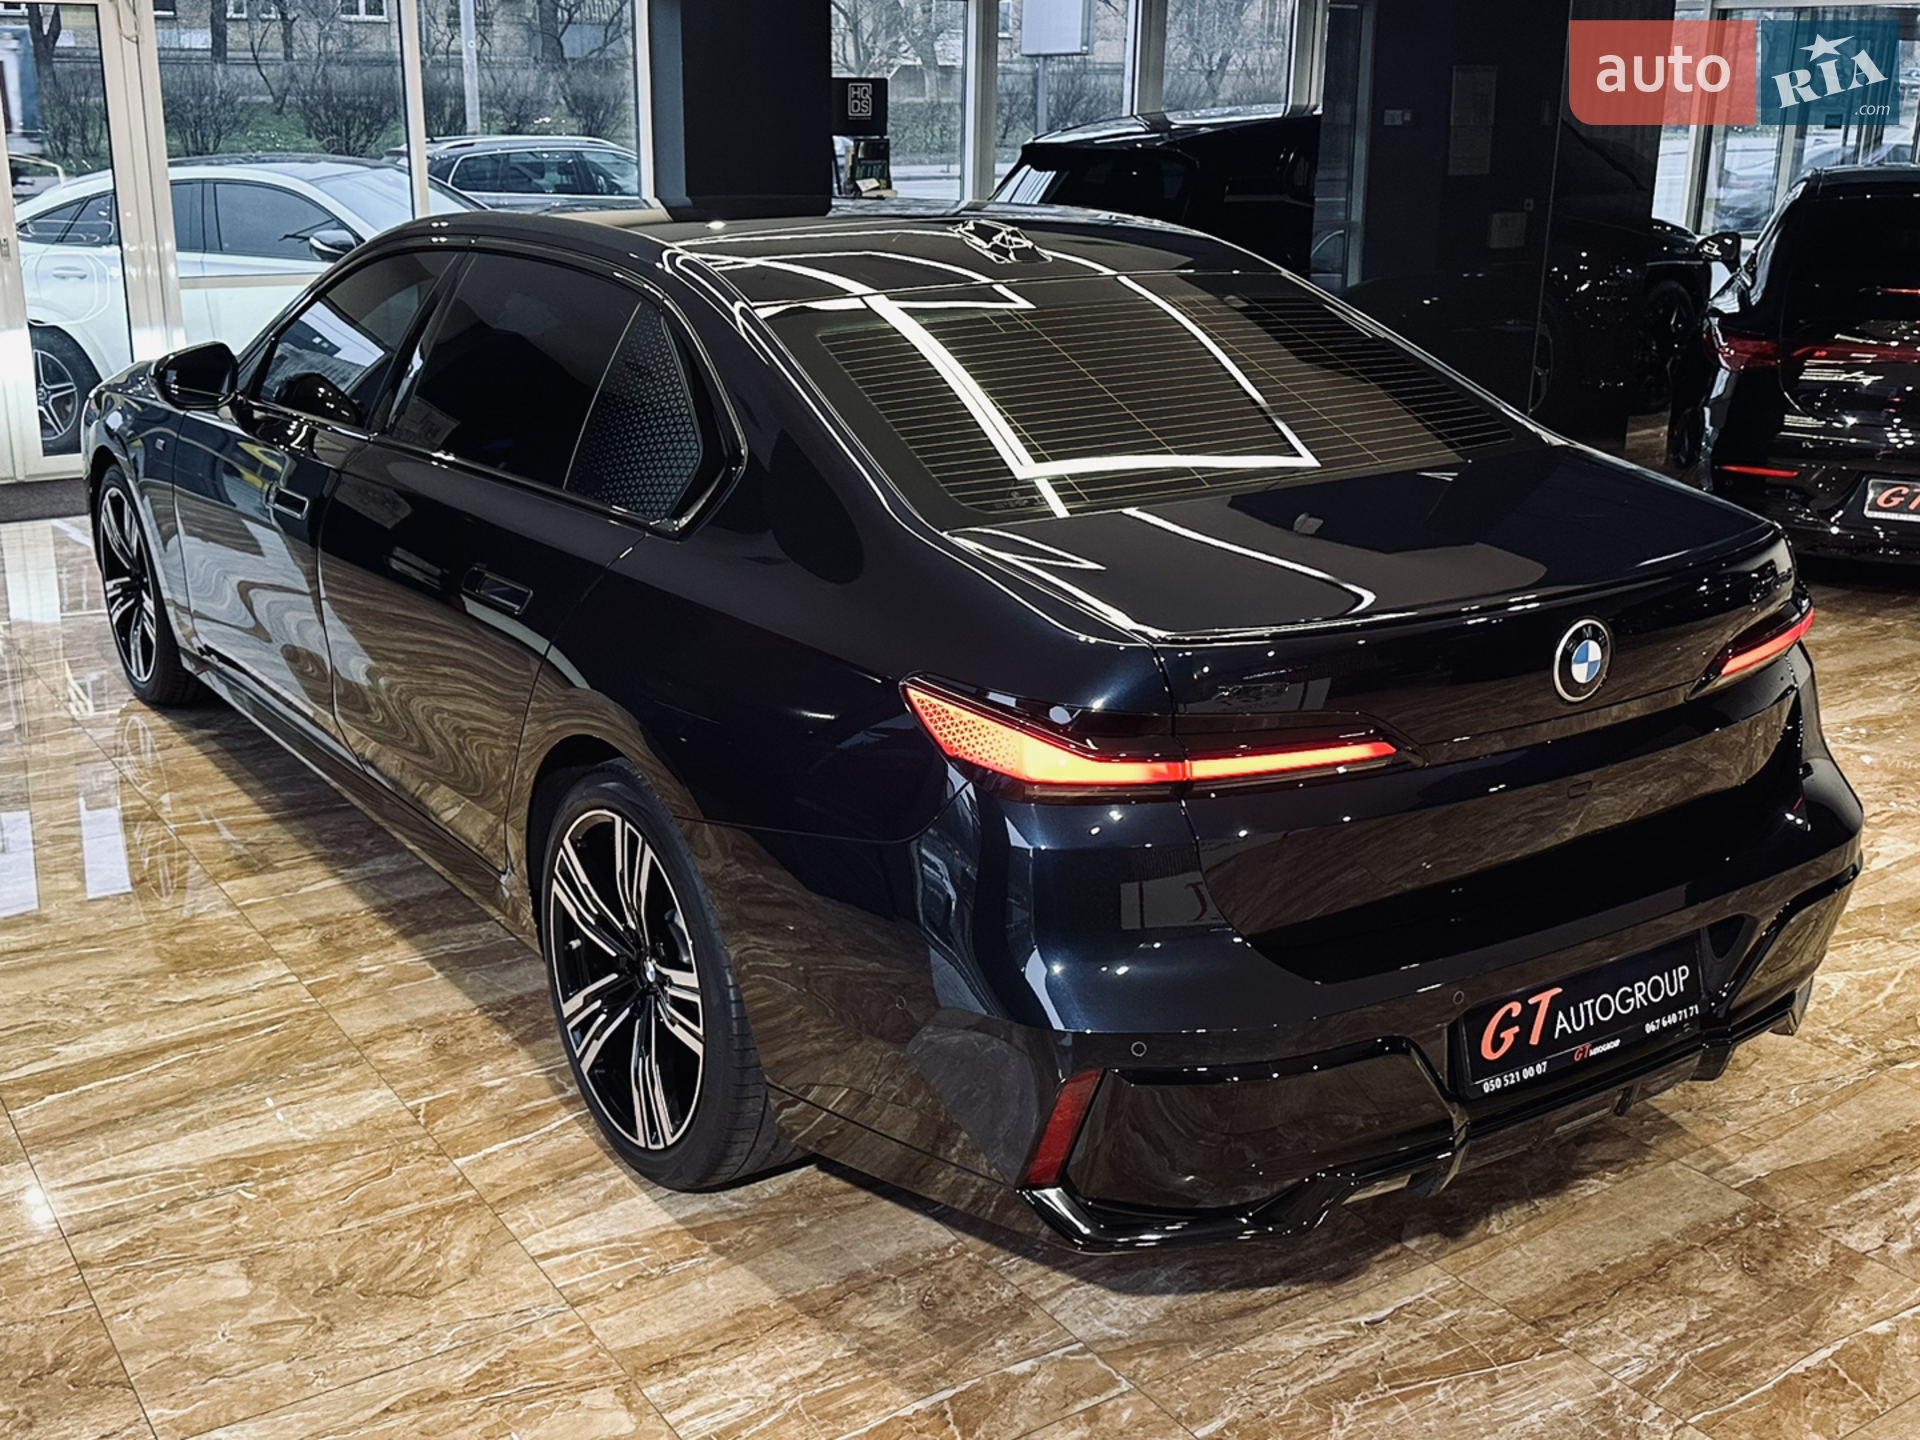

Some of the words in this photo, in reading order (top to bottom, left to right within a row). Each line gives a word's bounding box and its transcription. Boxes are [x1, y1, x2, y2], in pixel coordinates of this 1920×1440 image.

[1480, 987, 1563, 1060] GT
[1554, 965, 1690, 1039] AUTOGROUP
[1645, 1018, 1660, 1034] 067
[1677, 1008, 1688, 1021] 71
[1688, 1004, 1699, 1017] 71
[1483, 1077, 1502, 1093] 050
[1503, 1071, 1520, 1087] 521
[1522, 1066, 1535, 1079] 00
[1536, 1061, 1548, 1075] 07
